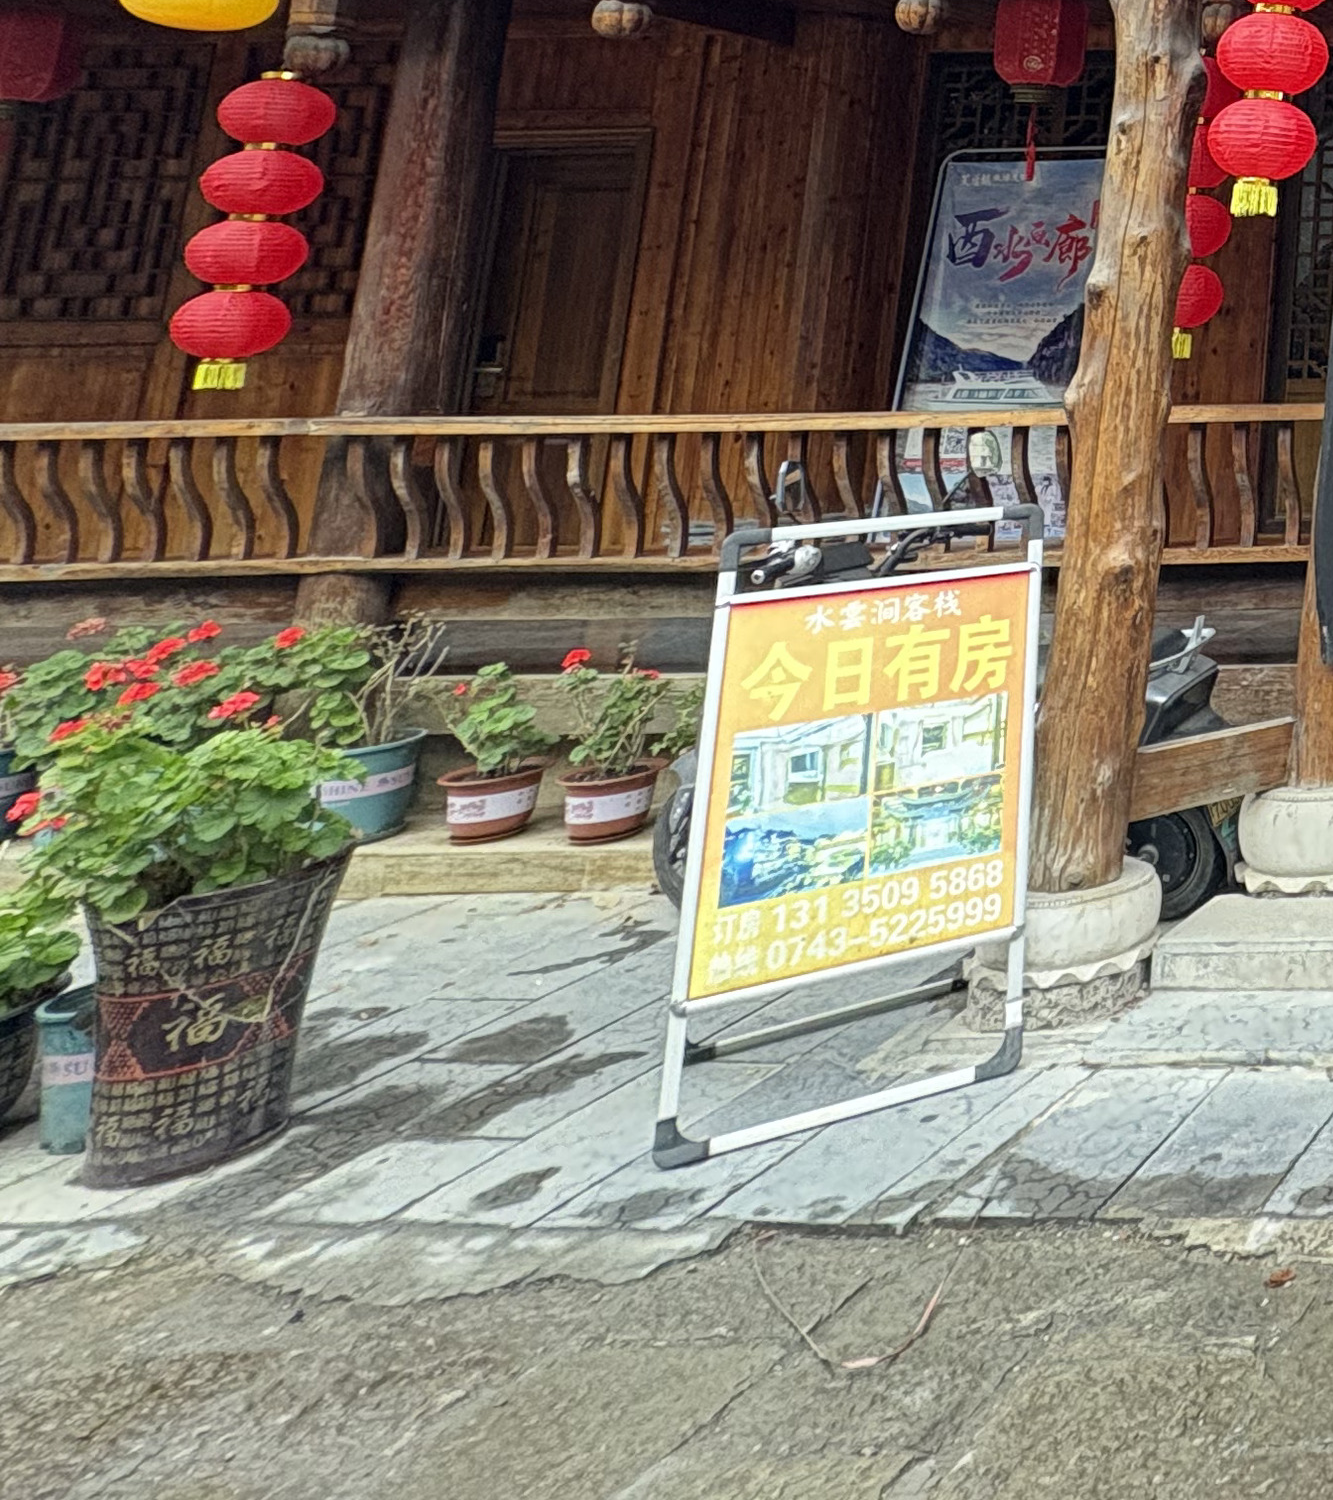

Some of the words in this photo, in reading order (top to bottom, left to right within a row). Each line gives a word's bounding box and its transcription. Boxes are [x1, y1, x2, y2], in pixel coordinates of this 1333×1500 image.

[739, 613, 1013, 722] 今日有房
[765, 892, 1002, 971] 0743-5225999
[771, 895, 829, 933] 131
[841, 876, 920, 918] 3509
[929, 858, 1004, 900] 5868
[160, 992, 228, 1052] 福
